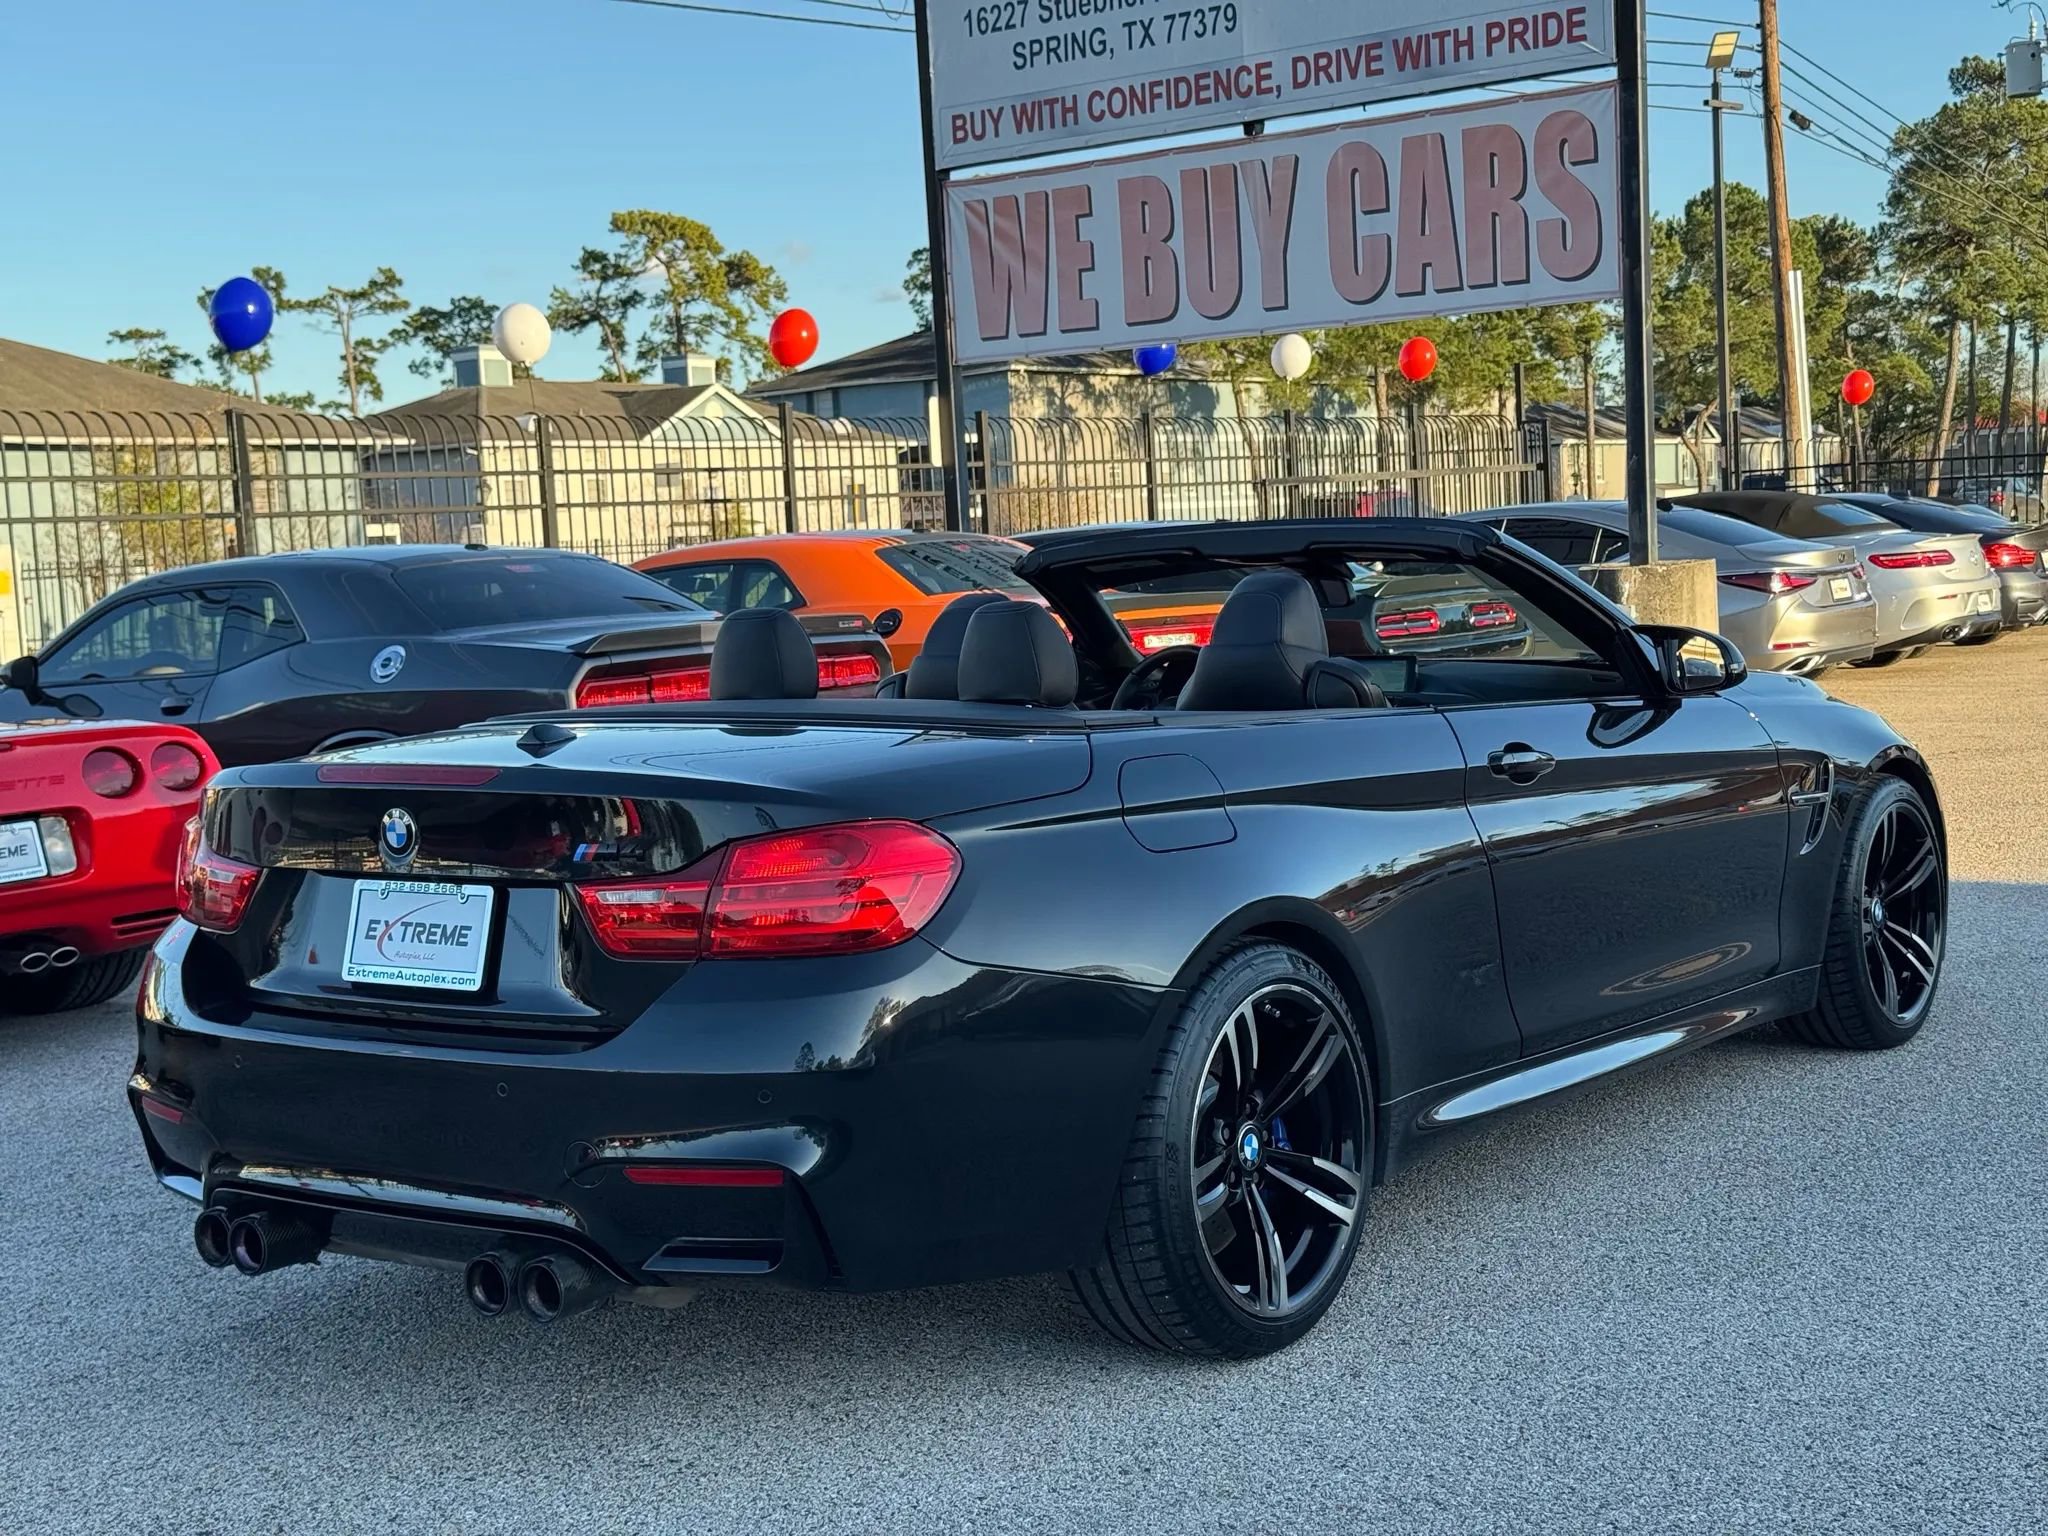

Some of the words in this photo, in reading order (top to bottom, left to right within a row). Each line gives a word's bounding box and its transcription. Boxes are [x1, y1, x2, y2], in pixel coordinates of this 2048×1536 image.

[963, 0, 1029, 38] 16227
[1012, 27, 1115, 71] SPRING,
[1122, 17, 1156, 51] TX
[1163, 3, 1237, 44] 77379
[951, 106, 1005, 145] BUY
[1011, 94, 1079, 135] WITH
[1087, 61, 1282, 123] CONFIDENCE,
[1291, 41, 1385, 90] DRIVE
[1392, 26, 1475, 73] WITH
[1486, 6, 1588, 58] PRIDE
[963, 184, 1099, 342] WE
[1117, 154, 1299, 328] BUY
[1326, 109, 1602, 304] CARS
[364, 919, 473, 947] EXTREME
[347, 966, 476, 987] ExtremeAutoplex.com
